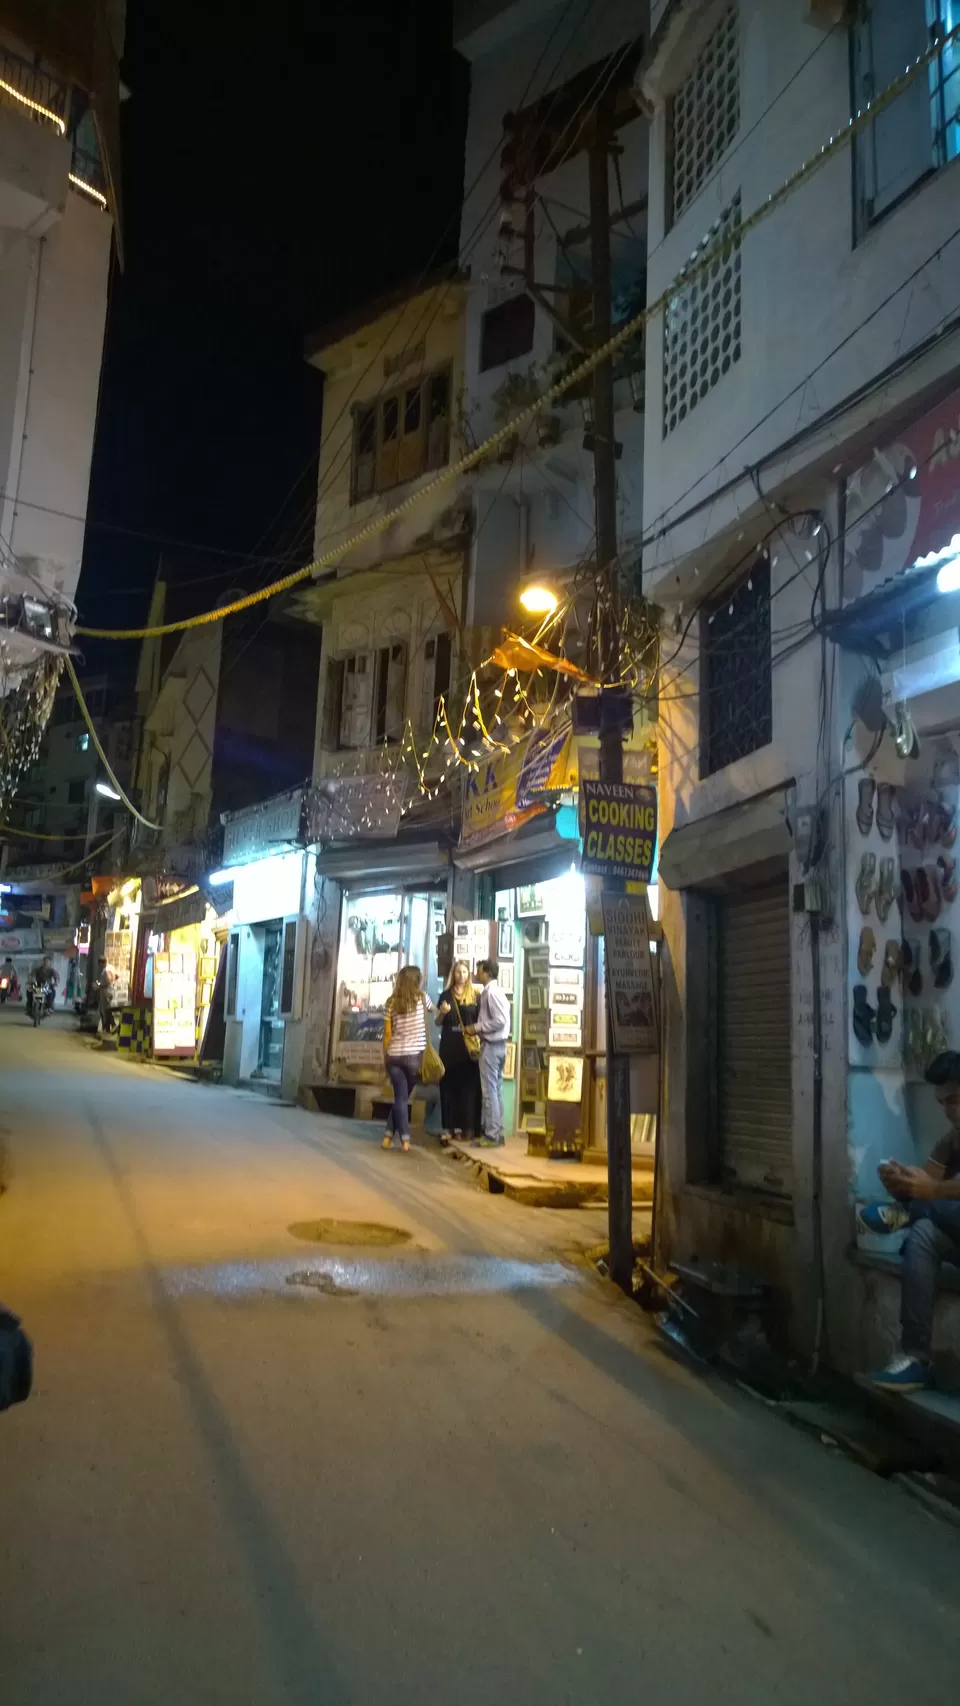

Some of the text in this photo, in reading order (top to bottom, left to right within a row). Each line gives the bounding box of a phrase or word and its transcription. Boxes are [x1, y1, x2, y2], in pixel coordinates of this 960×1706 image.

[586, 783, 634, 799] NAVEEN
[266, 806, 298, 834] SHOP
[588, 799, 655, 832] COOKING
[586, 831, 652, 866] CLASSES
[607, 909, 645, 925] SIDDHI
[607, 924, 646, 936] VINAYAK
[615, 939, 641, 948] BEAUTY
[613, 950, 645, 960] PARLOUR
[612, 967, 650, 977] AYURVEDIC
[615, 980, 648, 990] MASSAGE
